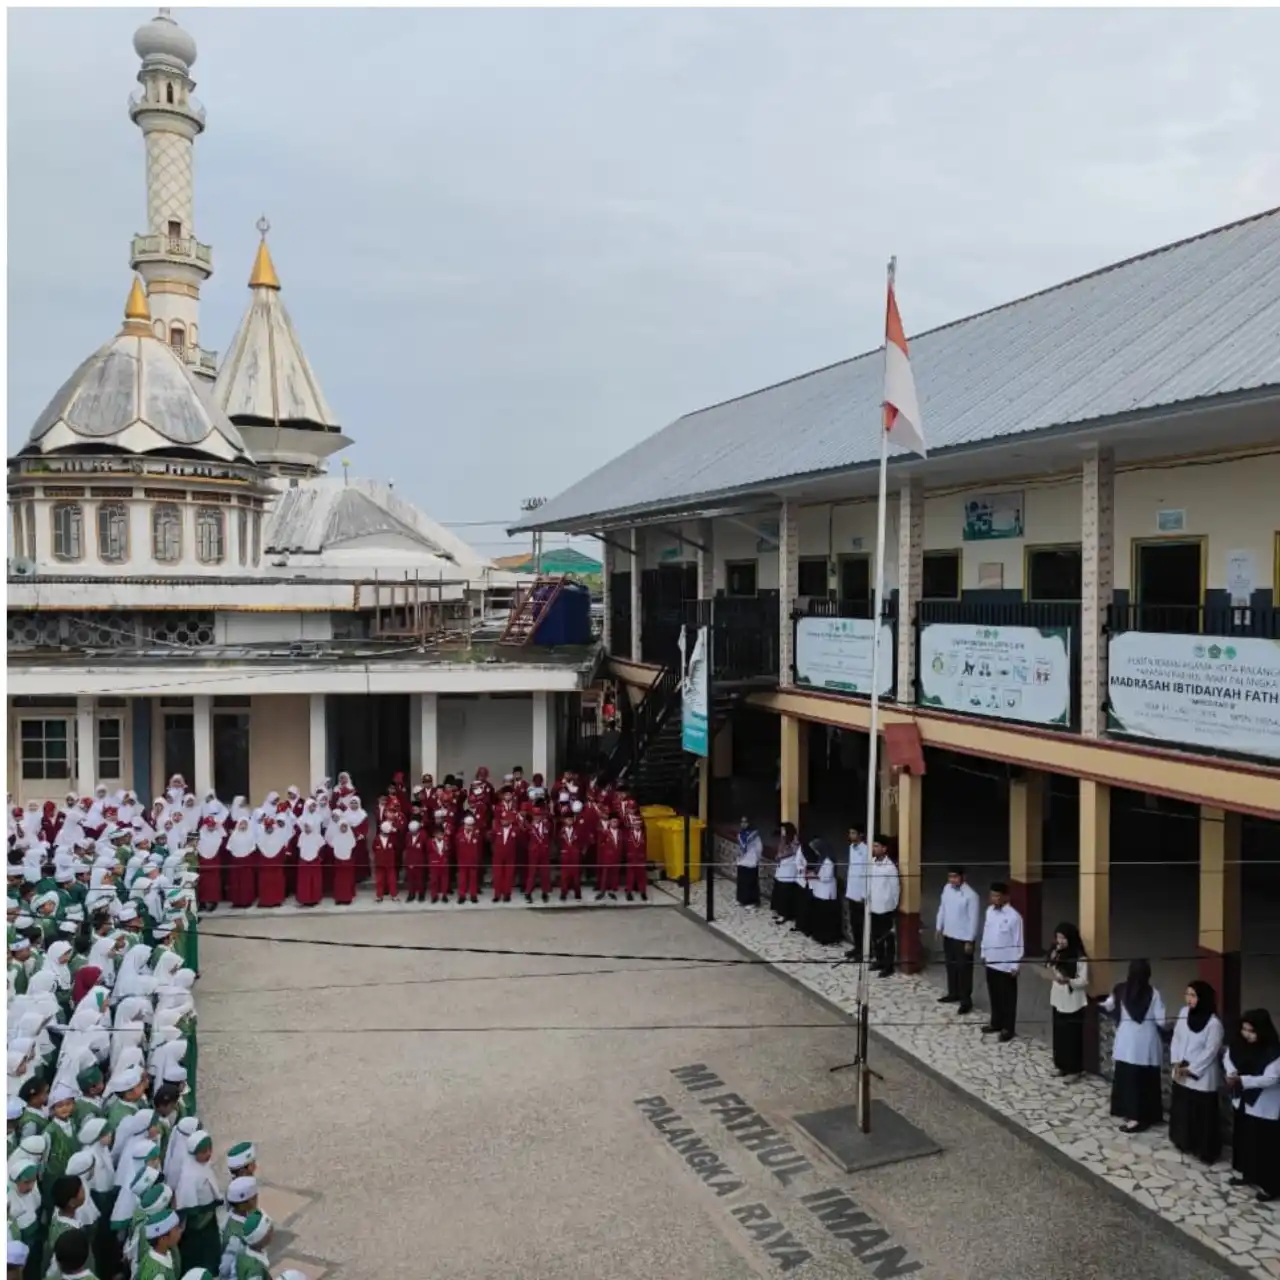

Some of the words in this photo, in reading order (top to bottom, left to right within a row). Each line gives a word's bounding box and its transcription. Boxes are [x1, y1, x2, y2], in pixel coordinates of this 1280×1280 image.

[1110, 676, 1170, 692] MADRASAH
[1173, 682, 1241, 700] IBTIDAIYAH
[633, 1095, 745, 1197] PALANGKA
[730, 1203, 813, 1271] RAYA
[670, 1064, 726, 1092] MI
[699, 1093, 818, 1187] FATHUL
[801, 1188, 924, 1280] IMAN
